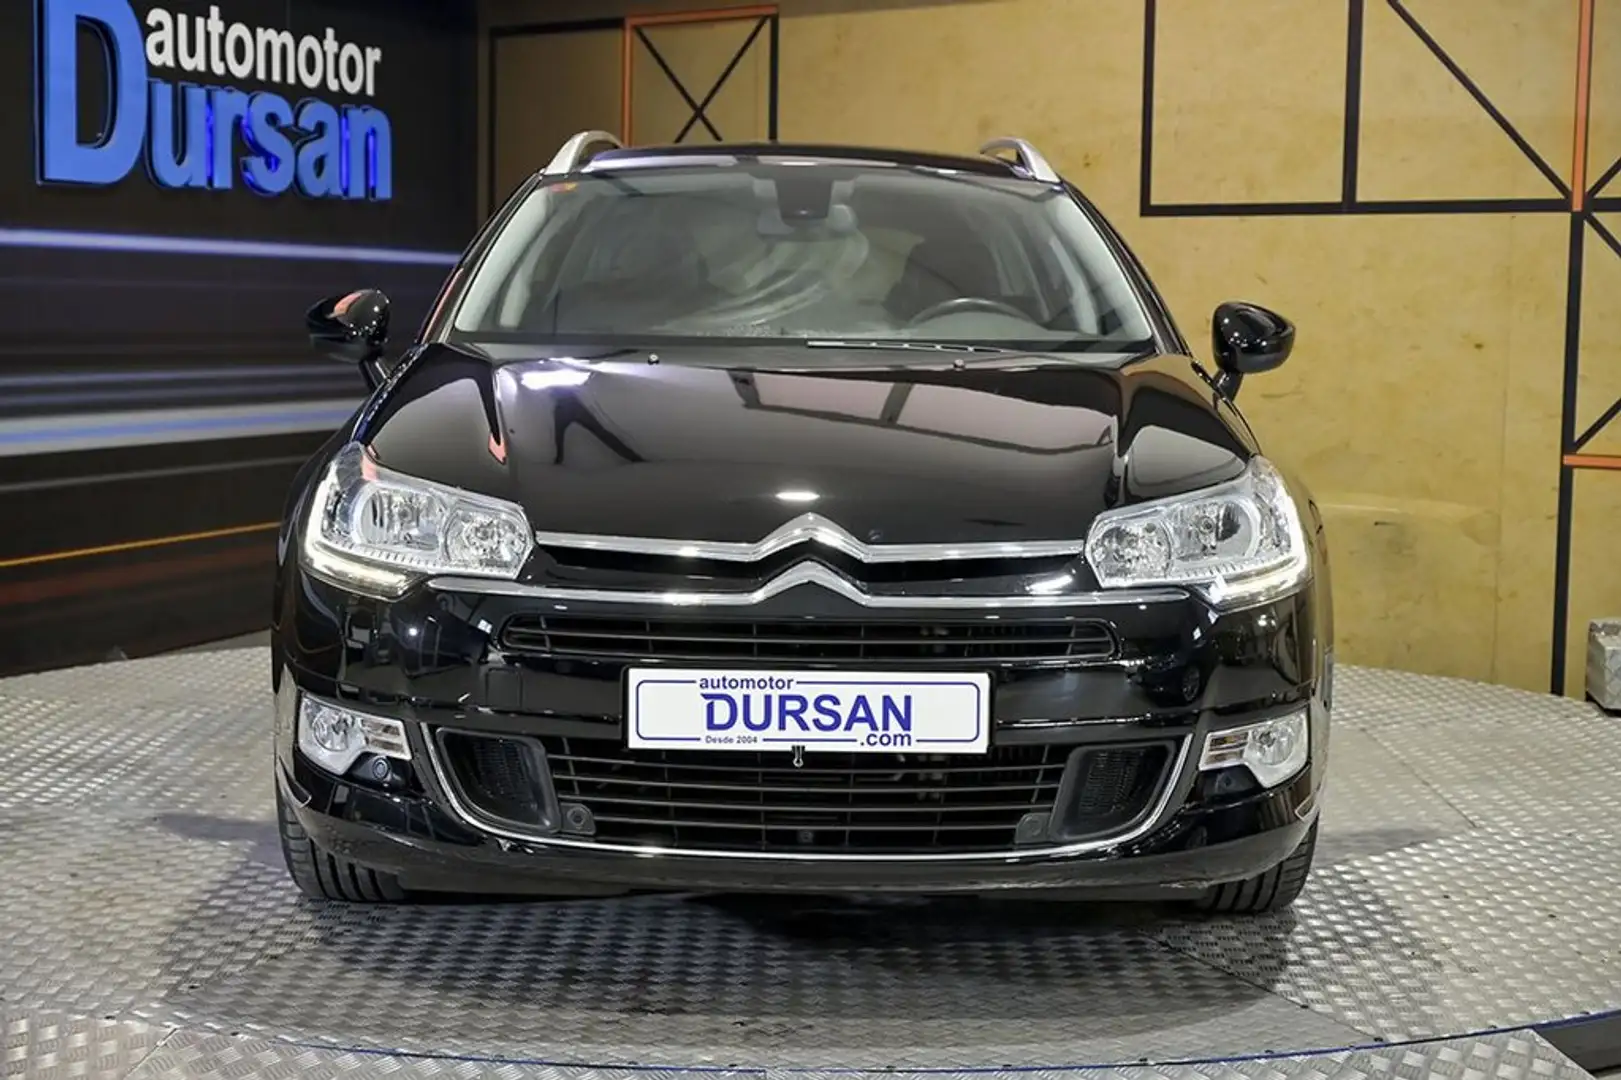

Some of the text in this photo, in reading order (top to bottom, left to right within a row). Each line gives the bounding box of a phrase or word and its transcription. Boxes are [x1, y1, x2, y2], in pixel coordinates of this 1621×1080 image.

[145, 5, 382, 97] automotor
[35, 0, 393, 200] Dursan
[699, 675, 795, 691] automotor
[700, 693, 912, 732] DURSAN
[705, 735, 732, 744] Desde
[859, 731, 912, 747] .com
